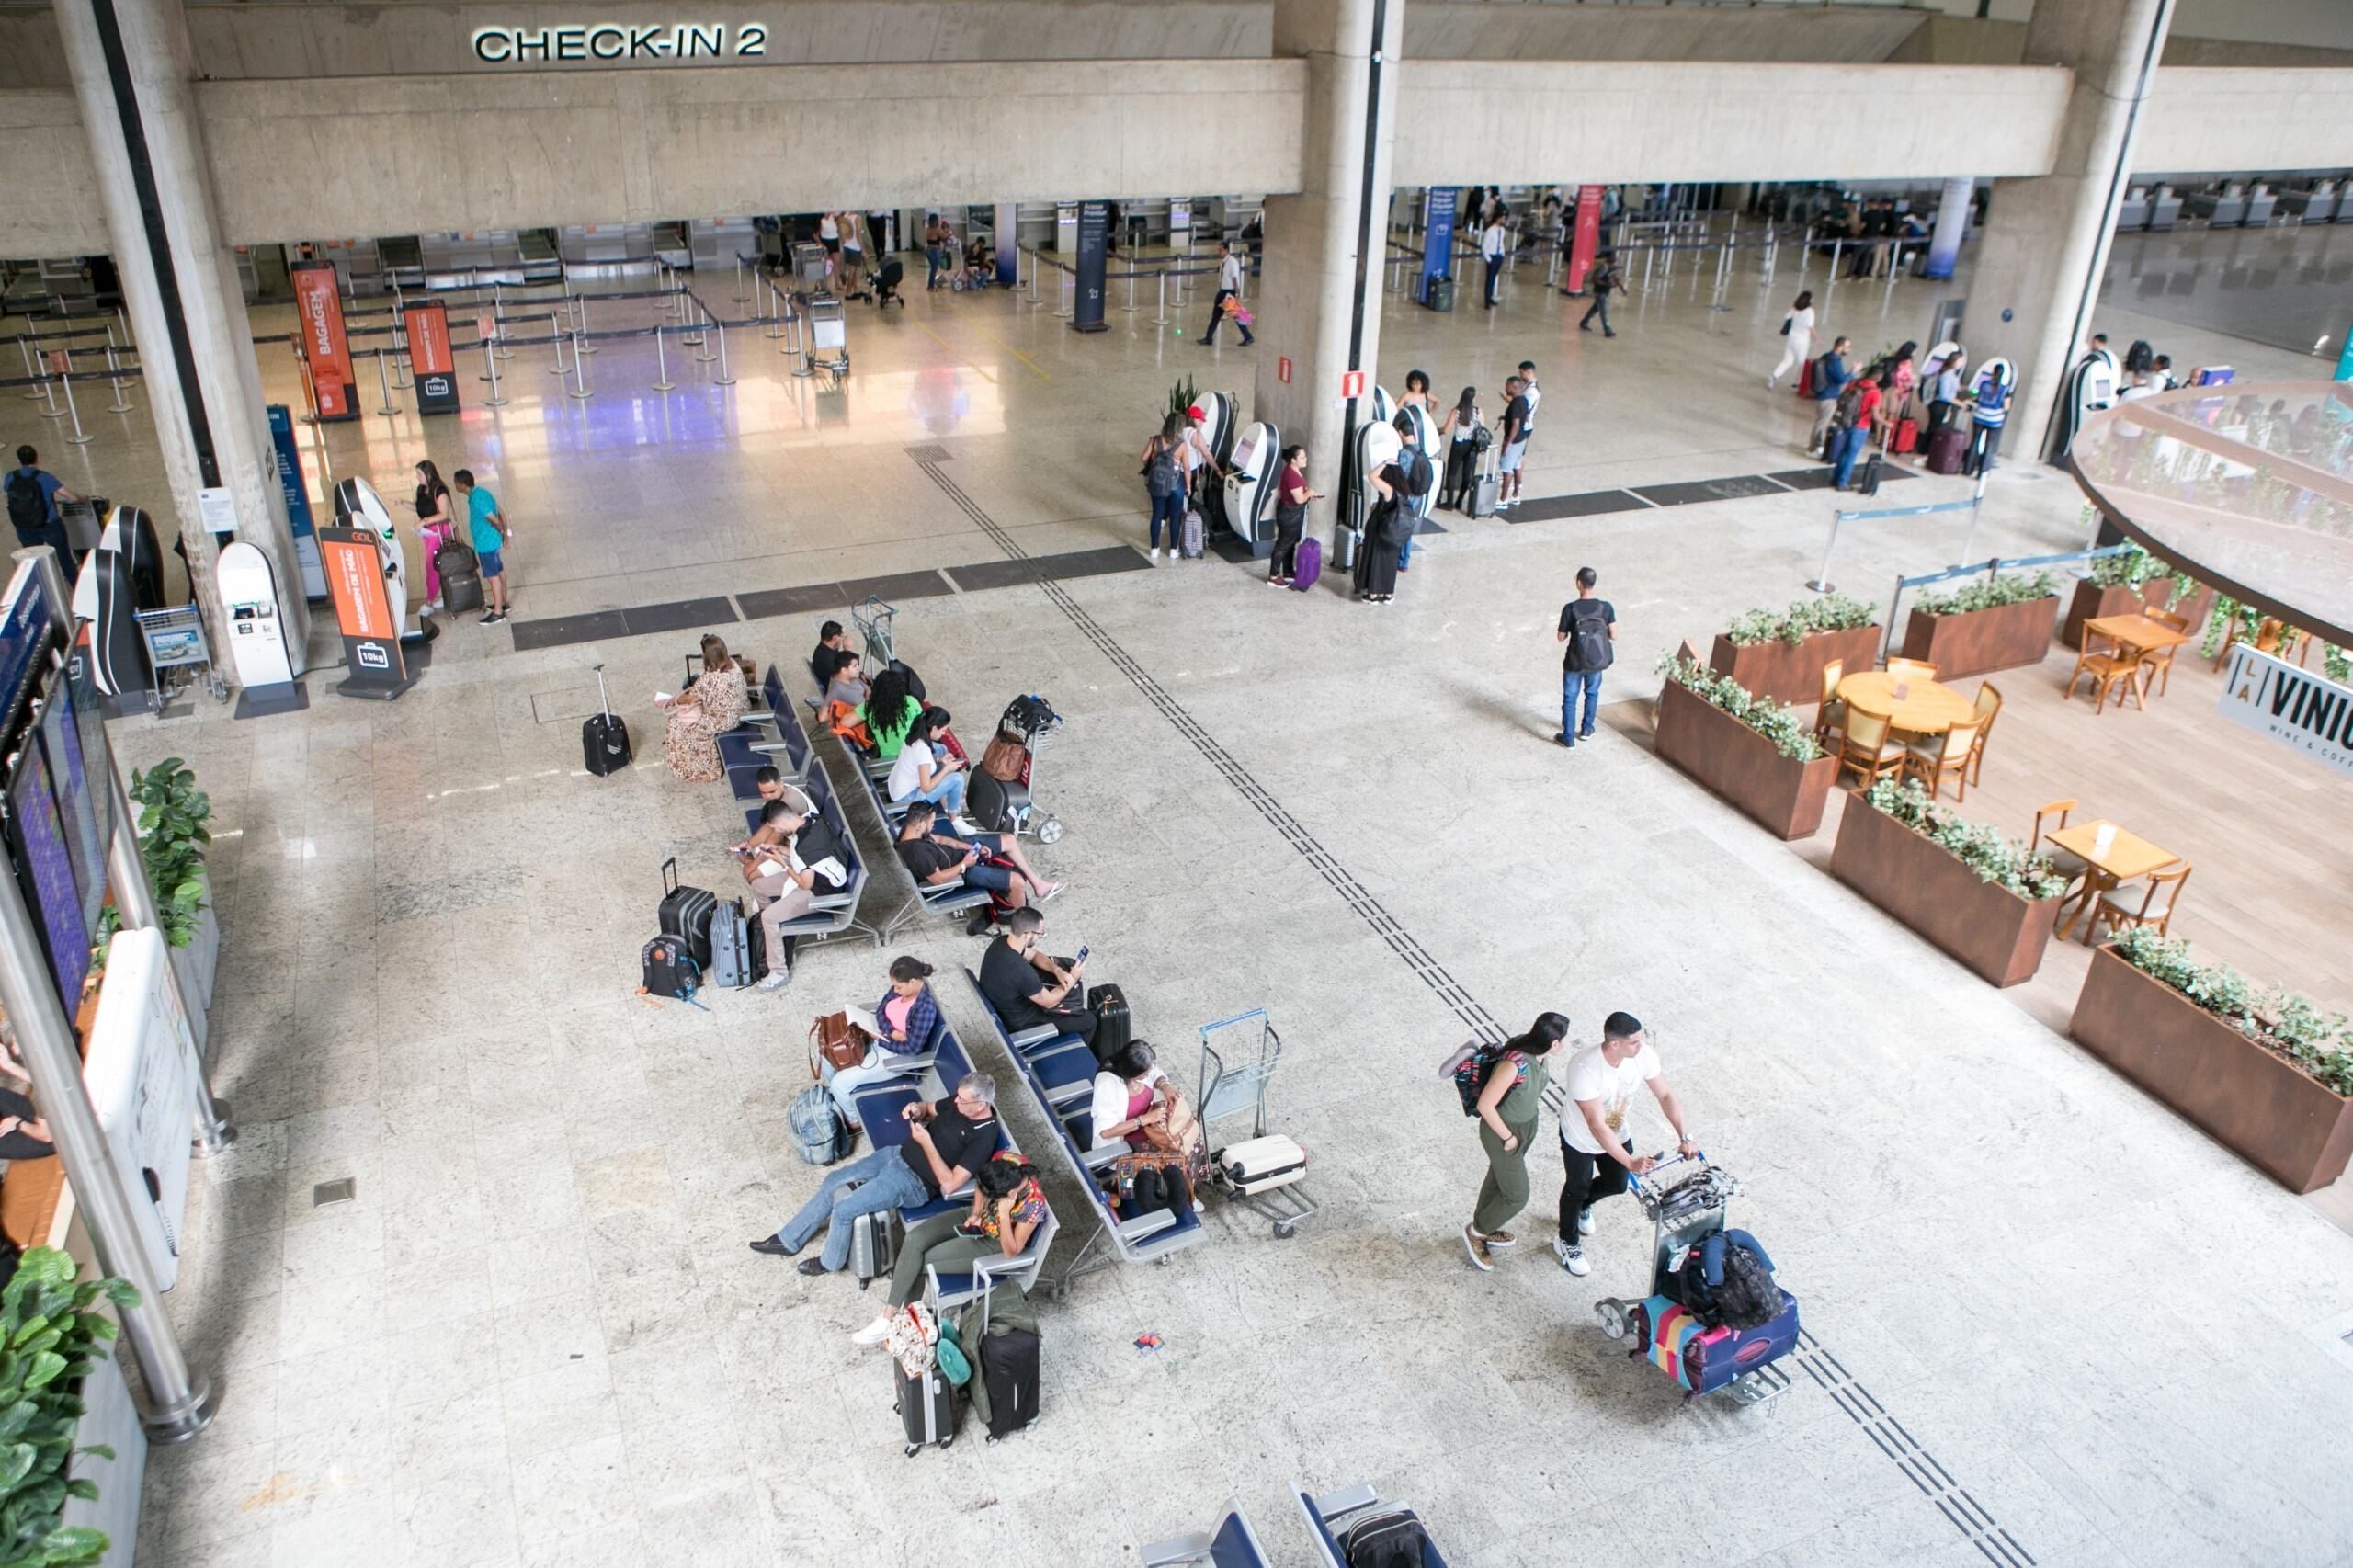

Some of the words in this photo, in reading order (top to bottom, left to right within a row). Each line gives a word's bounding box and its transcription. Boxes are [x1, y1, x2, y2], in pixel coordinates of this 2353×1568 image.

[473, 27, 723, 62] CHECK-IN
[737, 27, 767, 56] 2
[310, 290, 332, 355] BAGAGEM
[428, 383, 447, 393] 10kg
[352, 531, 373, 543] GOL
[345, 548, 357, 573] MÃO
[350, 573, 359, 585] DE
[362, 651, 385, 663] 10kg
[2269, 724, 2301, 743] WINE
[2307, 742, 2313, 750] &
